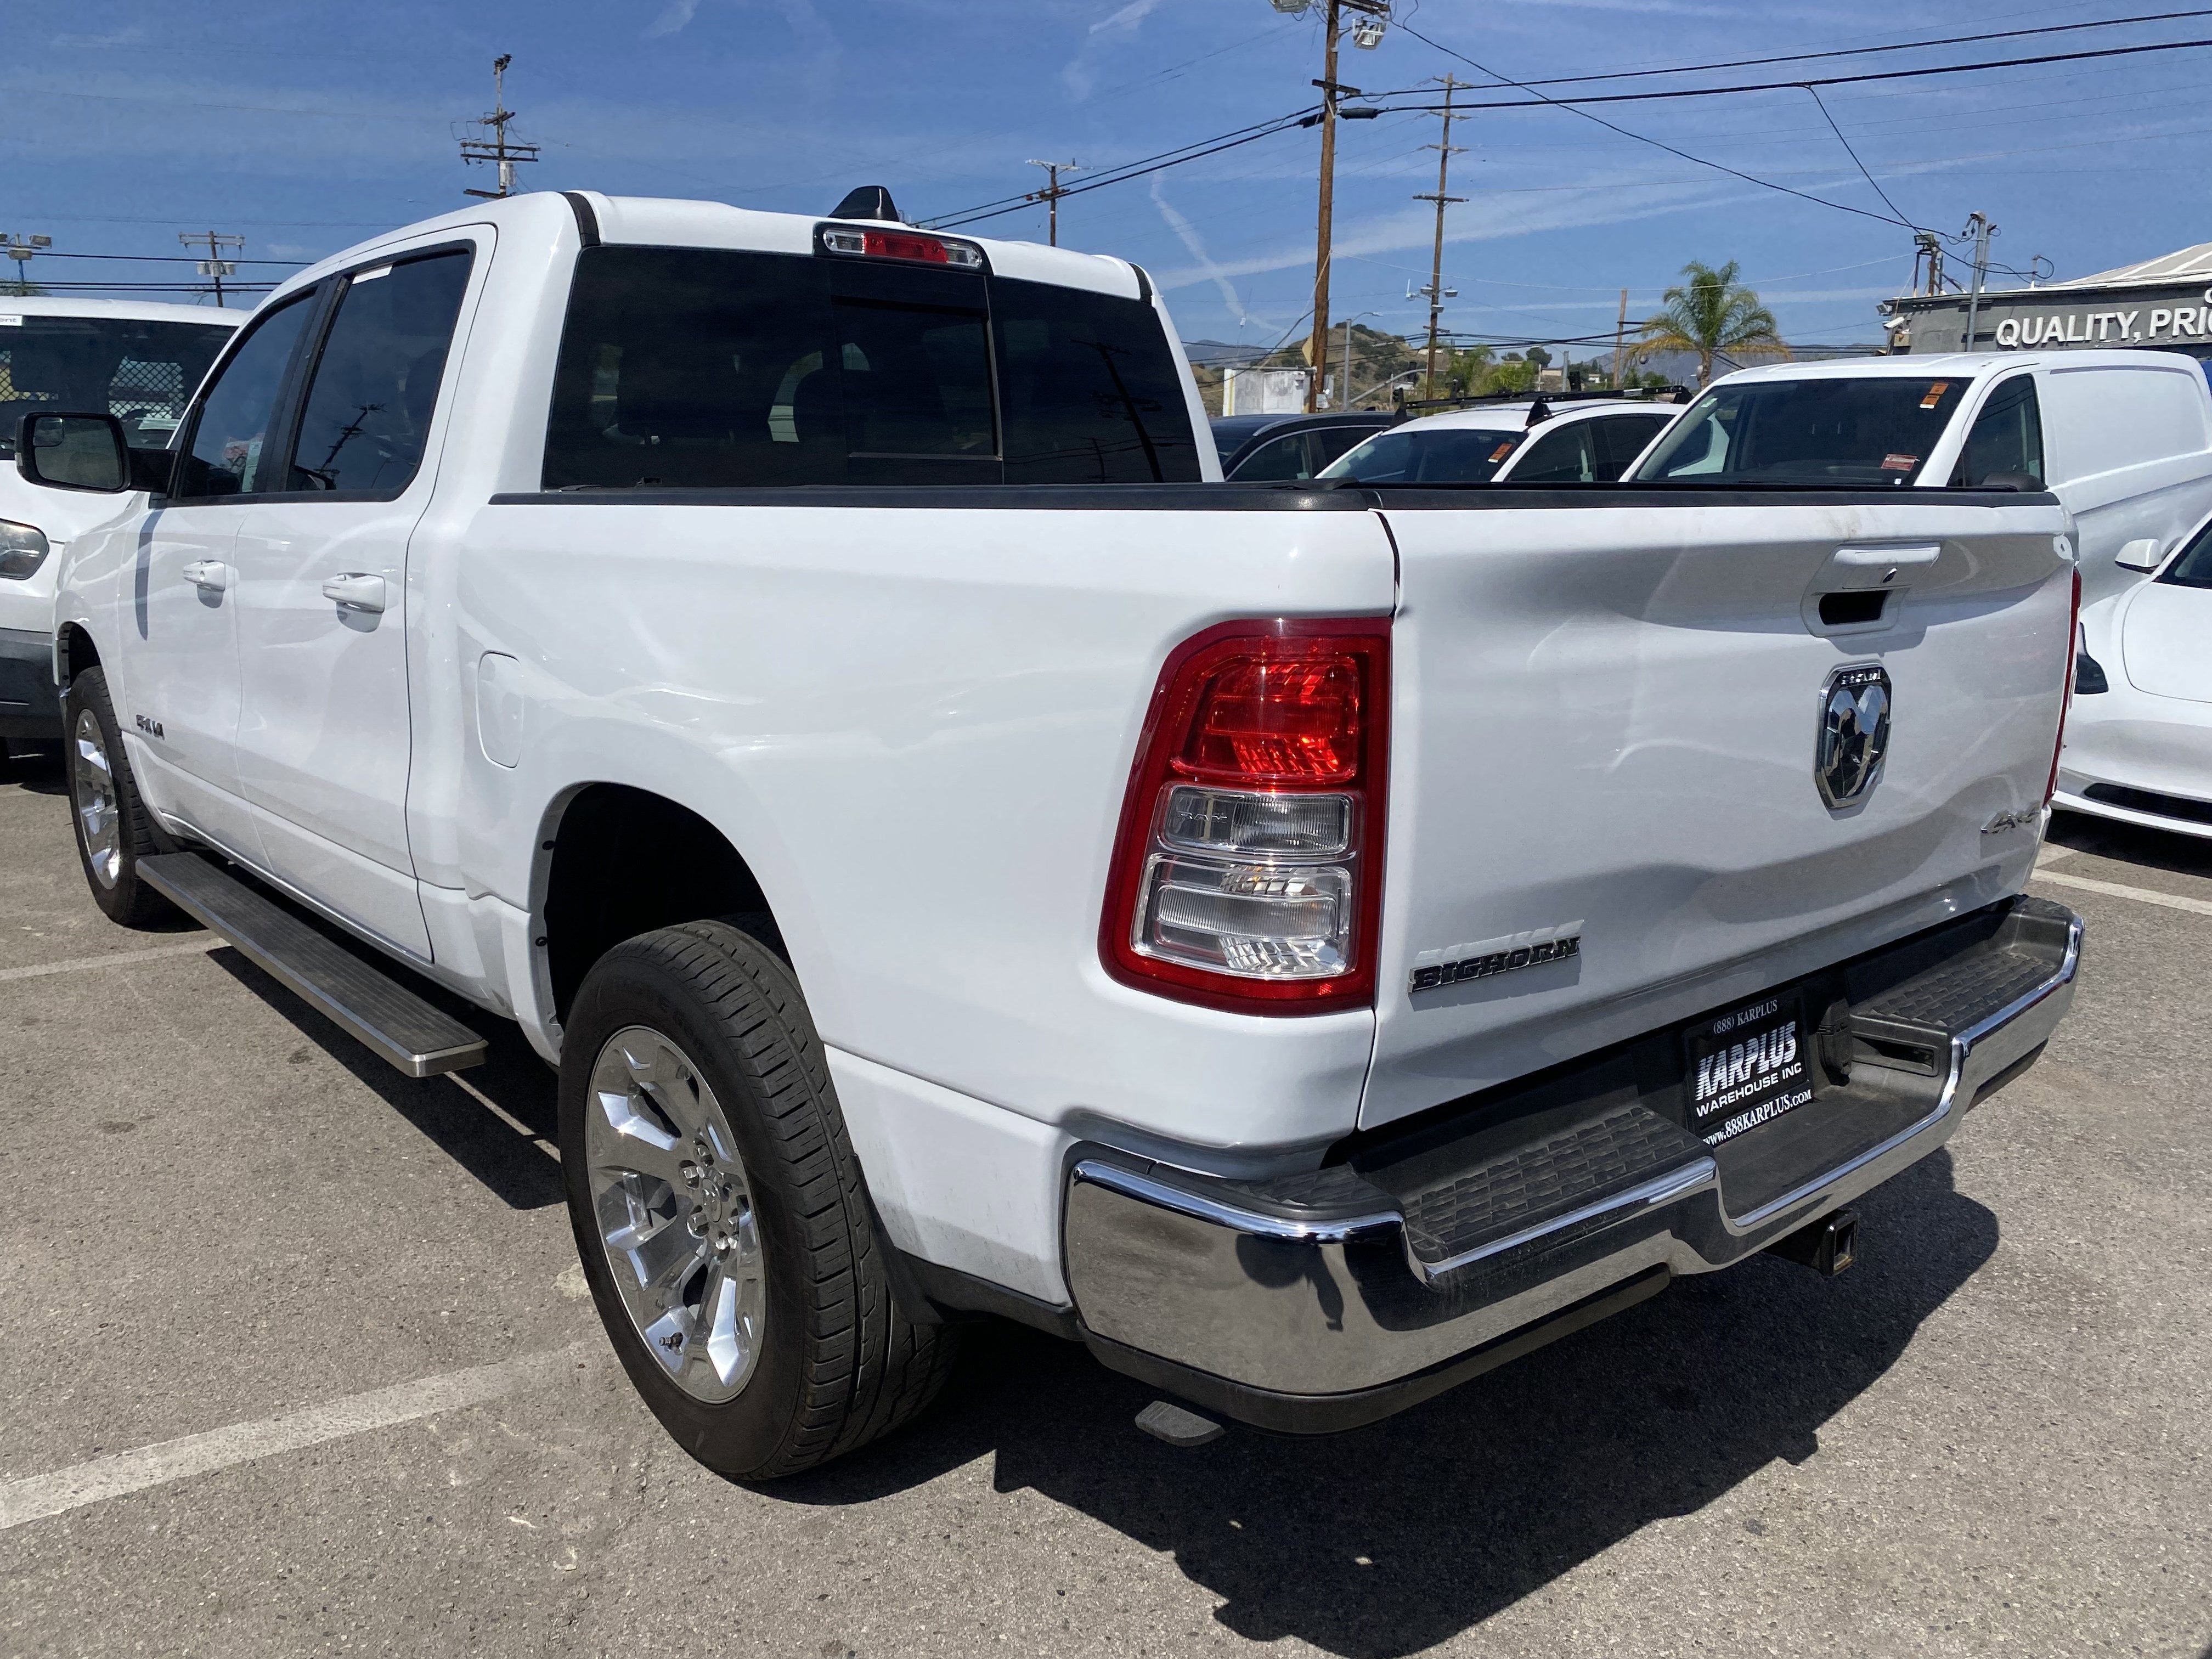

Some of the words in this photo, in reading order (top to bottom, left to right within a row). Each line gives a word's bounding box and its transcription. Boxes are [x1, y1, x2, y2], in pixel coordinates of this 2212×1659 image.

[1996, 311, 2142, 347] QUALITY,
[2148, 306, 2212, 337] PRI
[1841, 669, 1881, 685] RAM
[1407, 936, 1581, 994] BIGHORN
[1713, 1017, 1734, 1035] (888)
[1737, 1000, 1778, 1025] KARPLUS
[1696, 1021, 1796, 1101] KARPLUS
[1696, 1073, 1779, 1118] WAREHOUSE
[1782, 1062, 1802, 1080] INC
